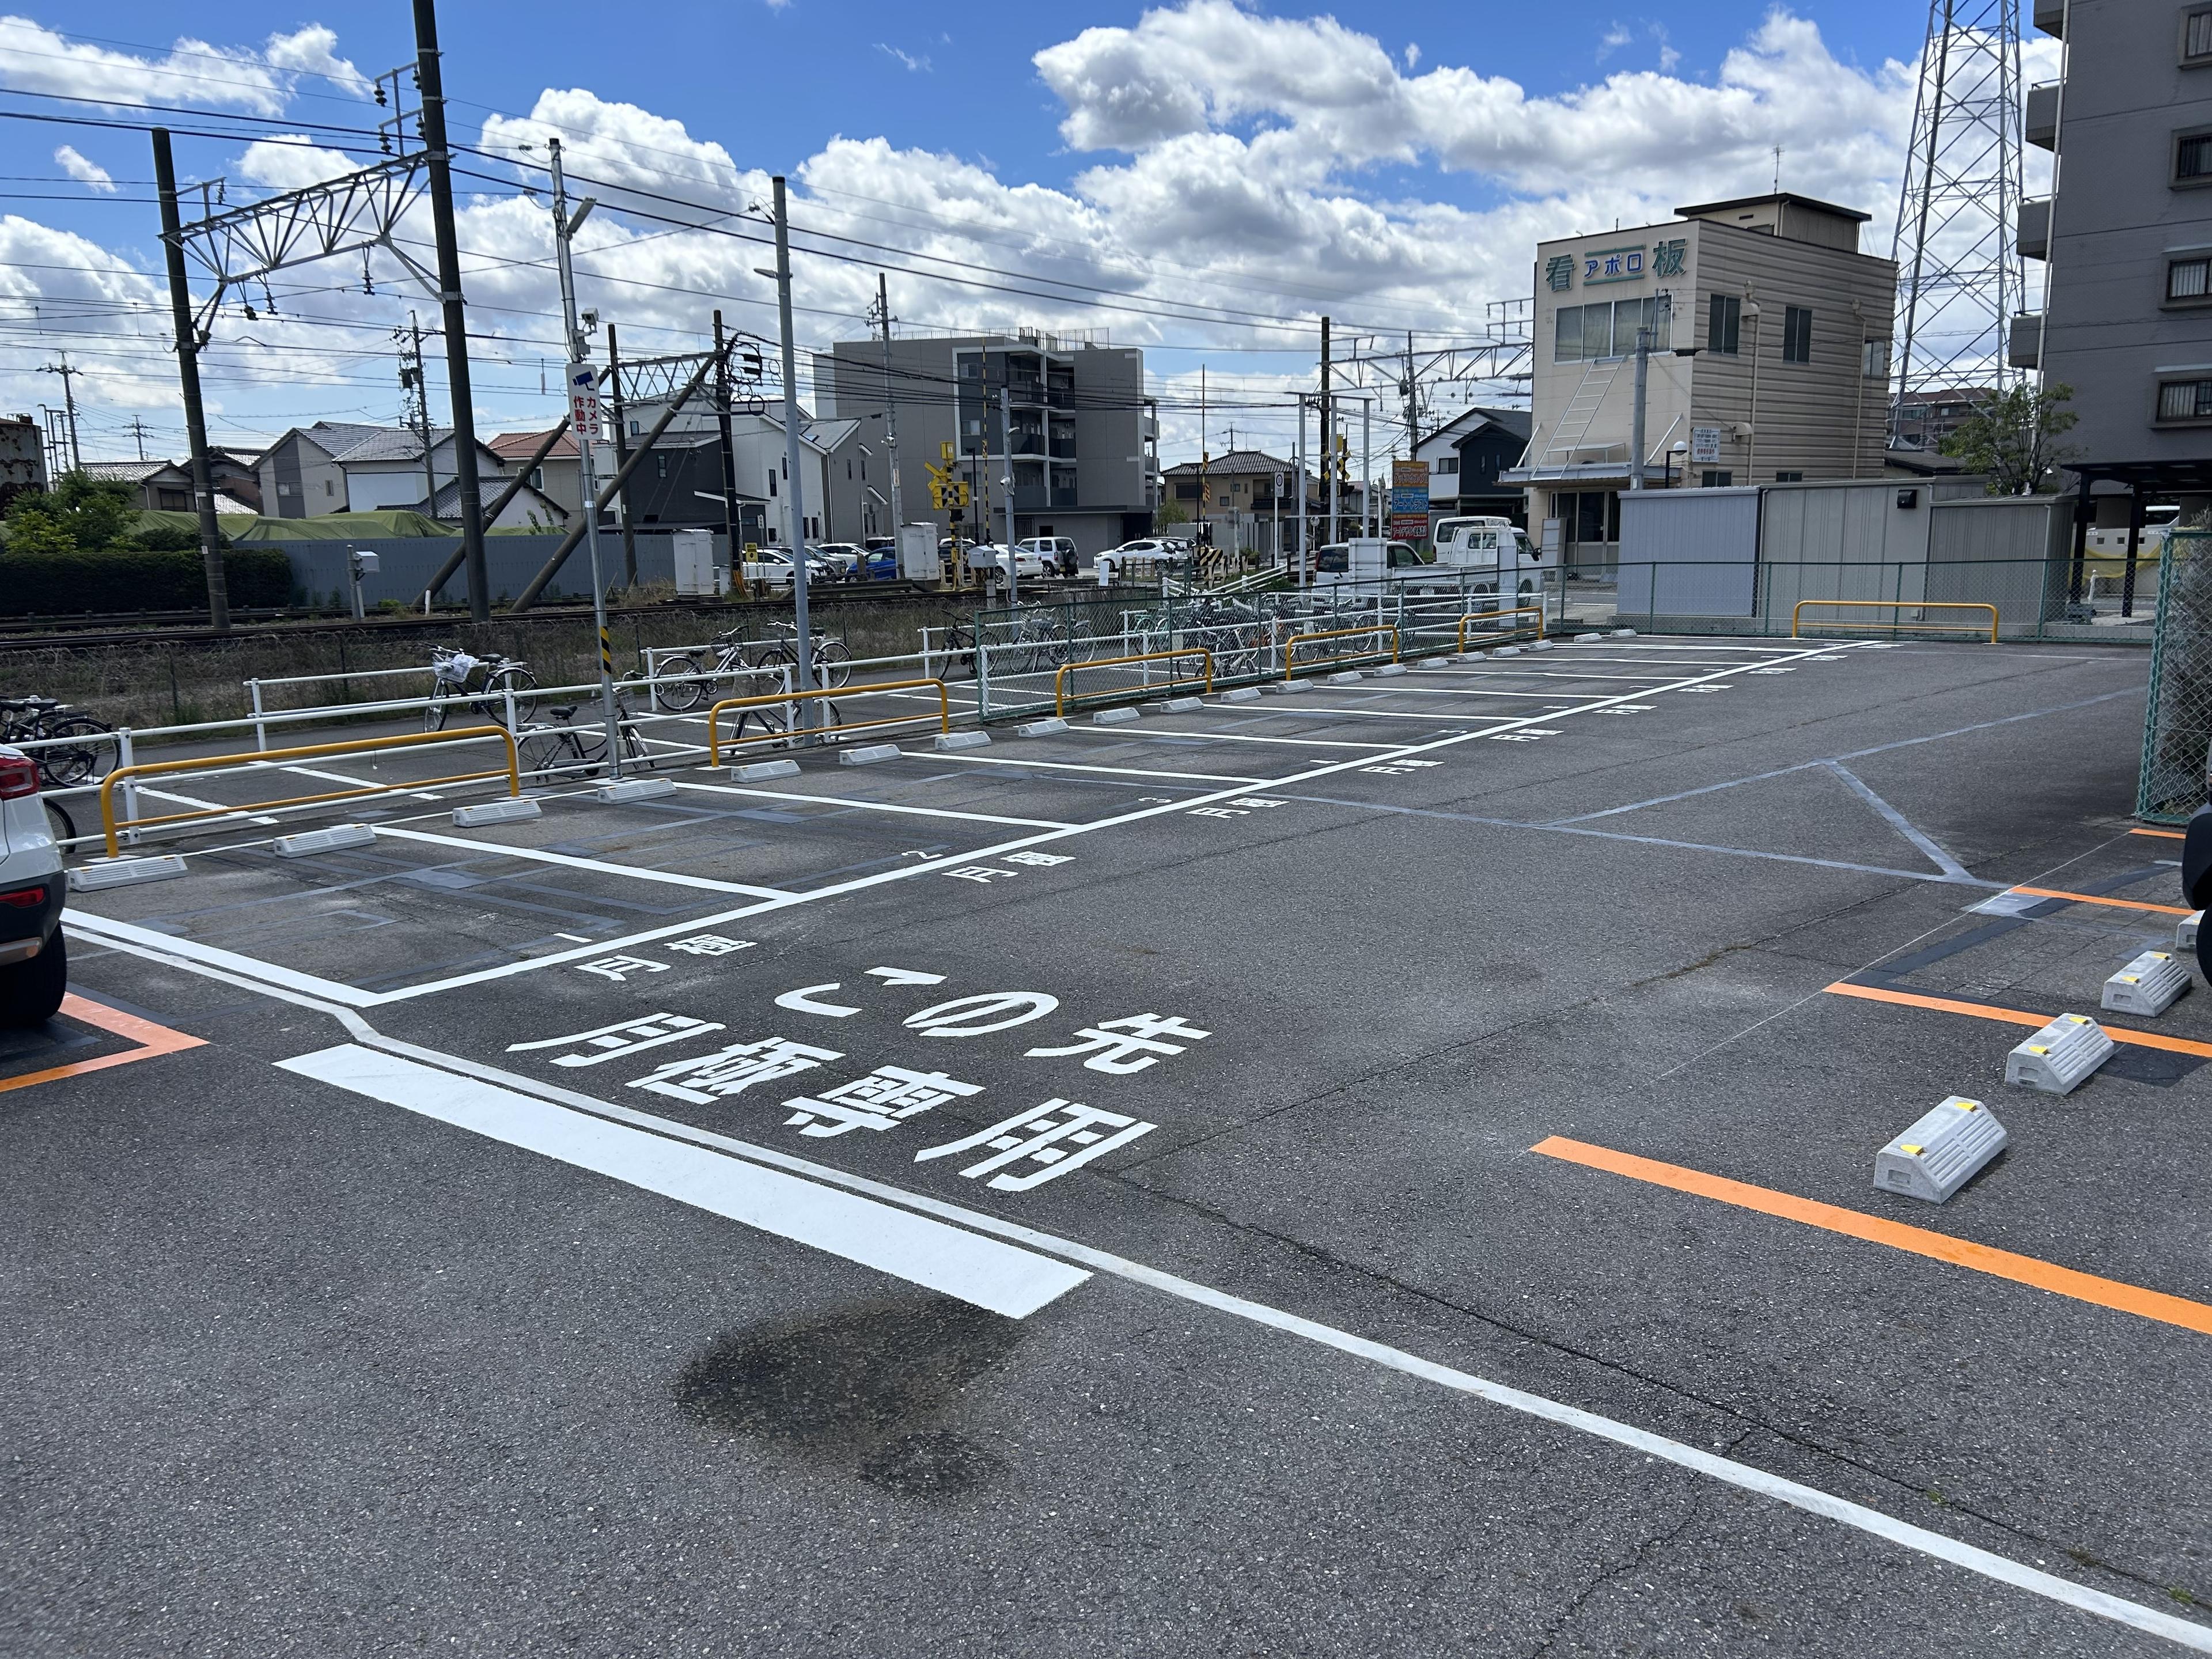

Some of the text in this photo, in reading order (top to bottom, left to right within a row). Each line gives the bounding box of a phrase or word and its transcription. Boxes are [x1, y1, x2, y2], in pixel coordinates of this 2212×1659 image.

[1585, 253, 1642, 278] アポロ
[574, 395, 586, 435] 作動中
[586, 396, 599, 434] カメラ
[1185, 798, 1290, 819] 月極
[901, 851, 944, 859] 2
[941, 851, 1077, 883] 月極
[554, 933, 593, 943] 1
[574, 934, 758, 981] 月極
[775, 967, 1213, 1074] この先
[505, 1013, 1158, 1192] 月極専用
